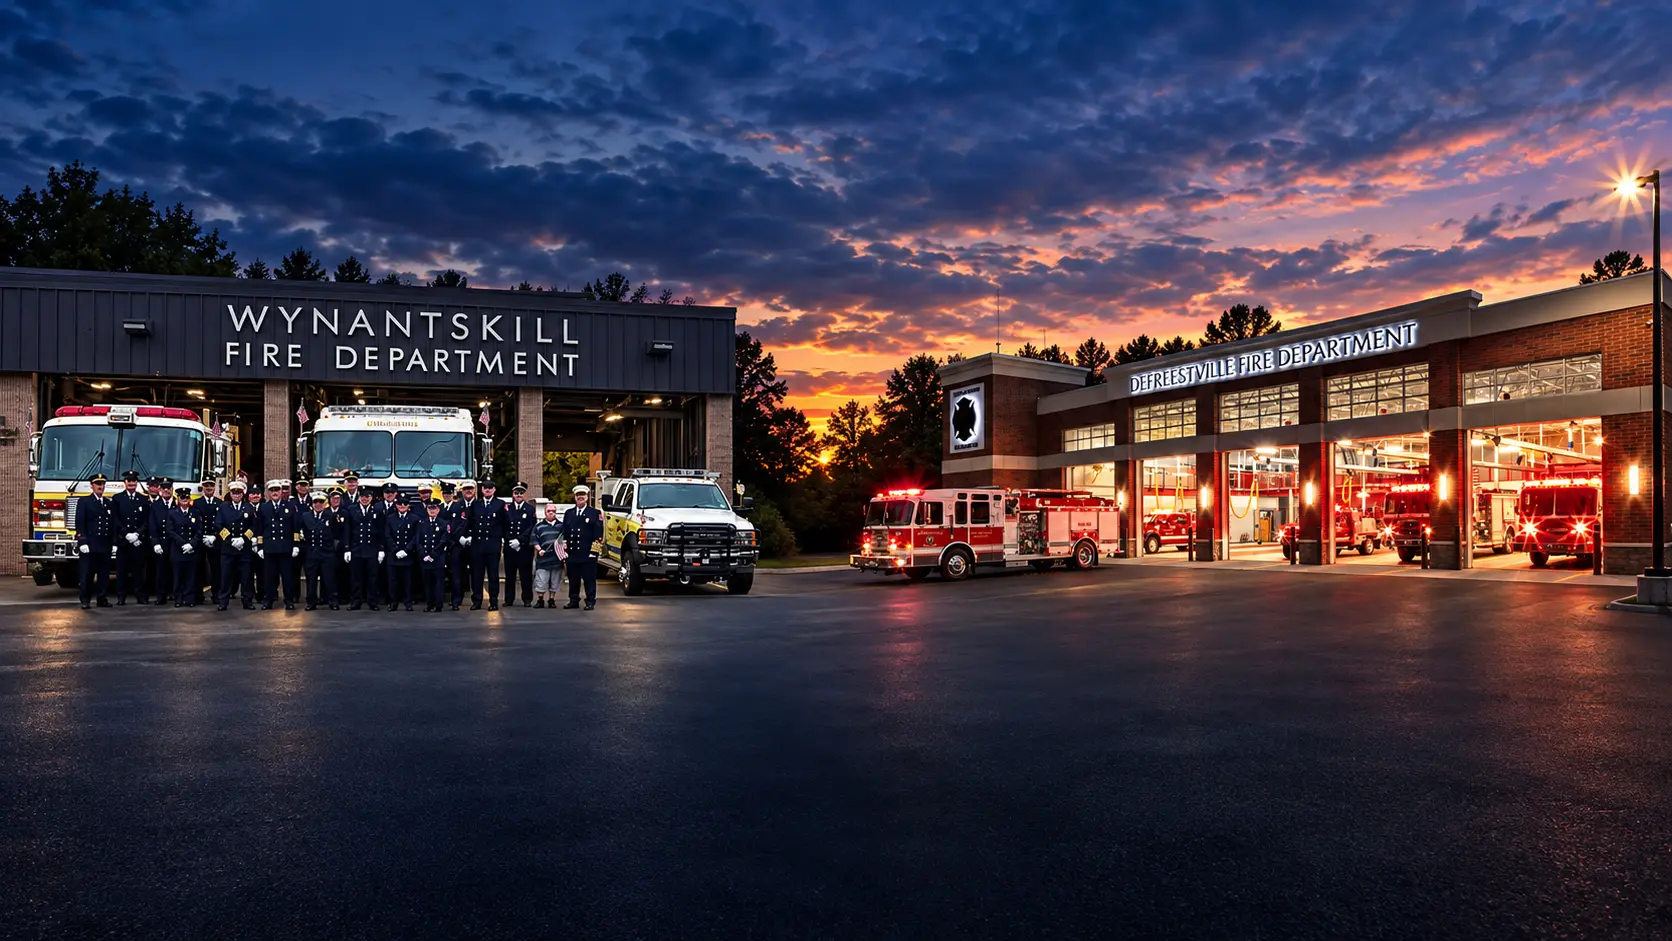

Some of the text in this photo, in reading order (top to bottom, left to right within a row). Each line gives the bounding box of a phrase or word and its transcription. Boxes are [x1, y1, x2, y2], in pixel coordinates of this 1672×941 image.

[226, 304, 580, 344] WYNANTSKILL
[225, 342, 580, 377] FIRE DEPARTMENT
[1130, 322, 1418, 394] DEFREESTVILLE FIRE DEPARTMENT
